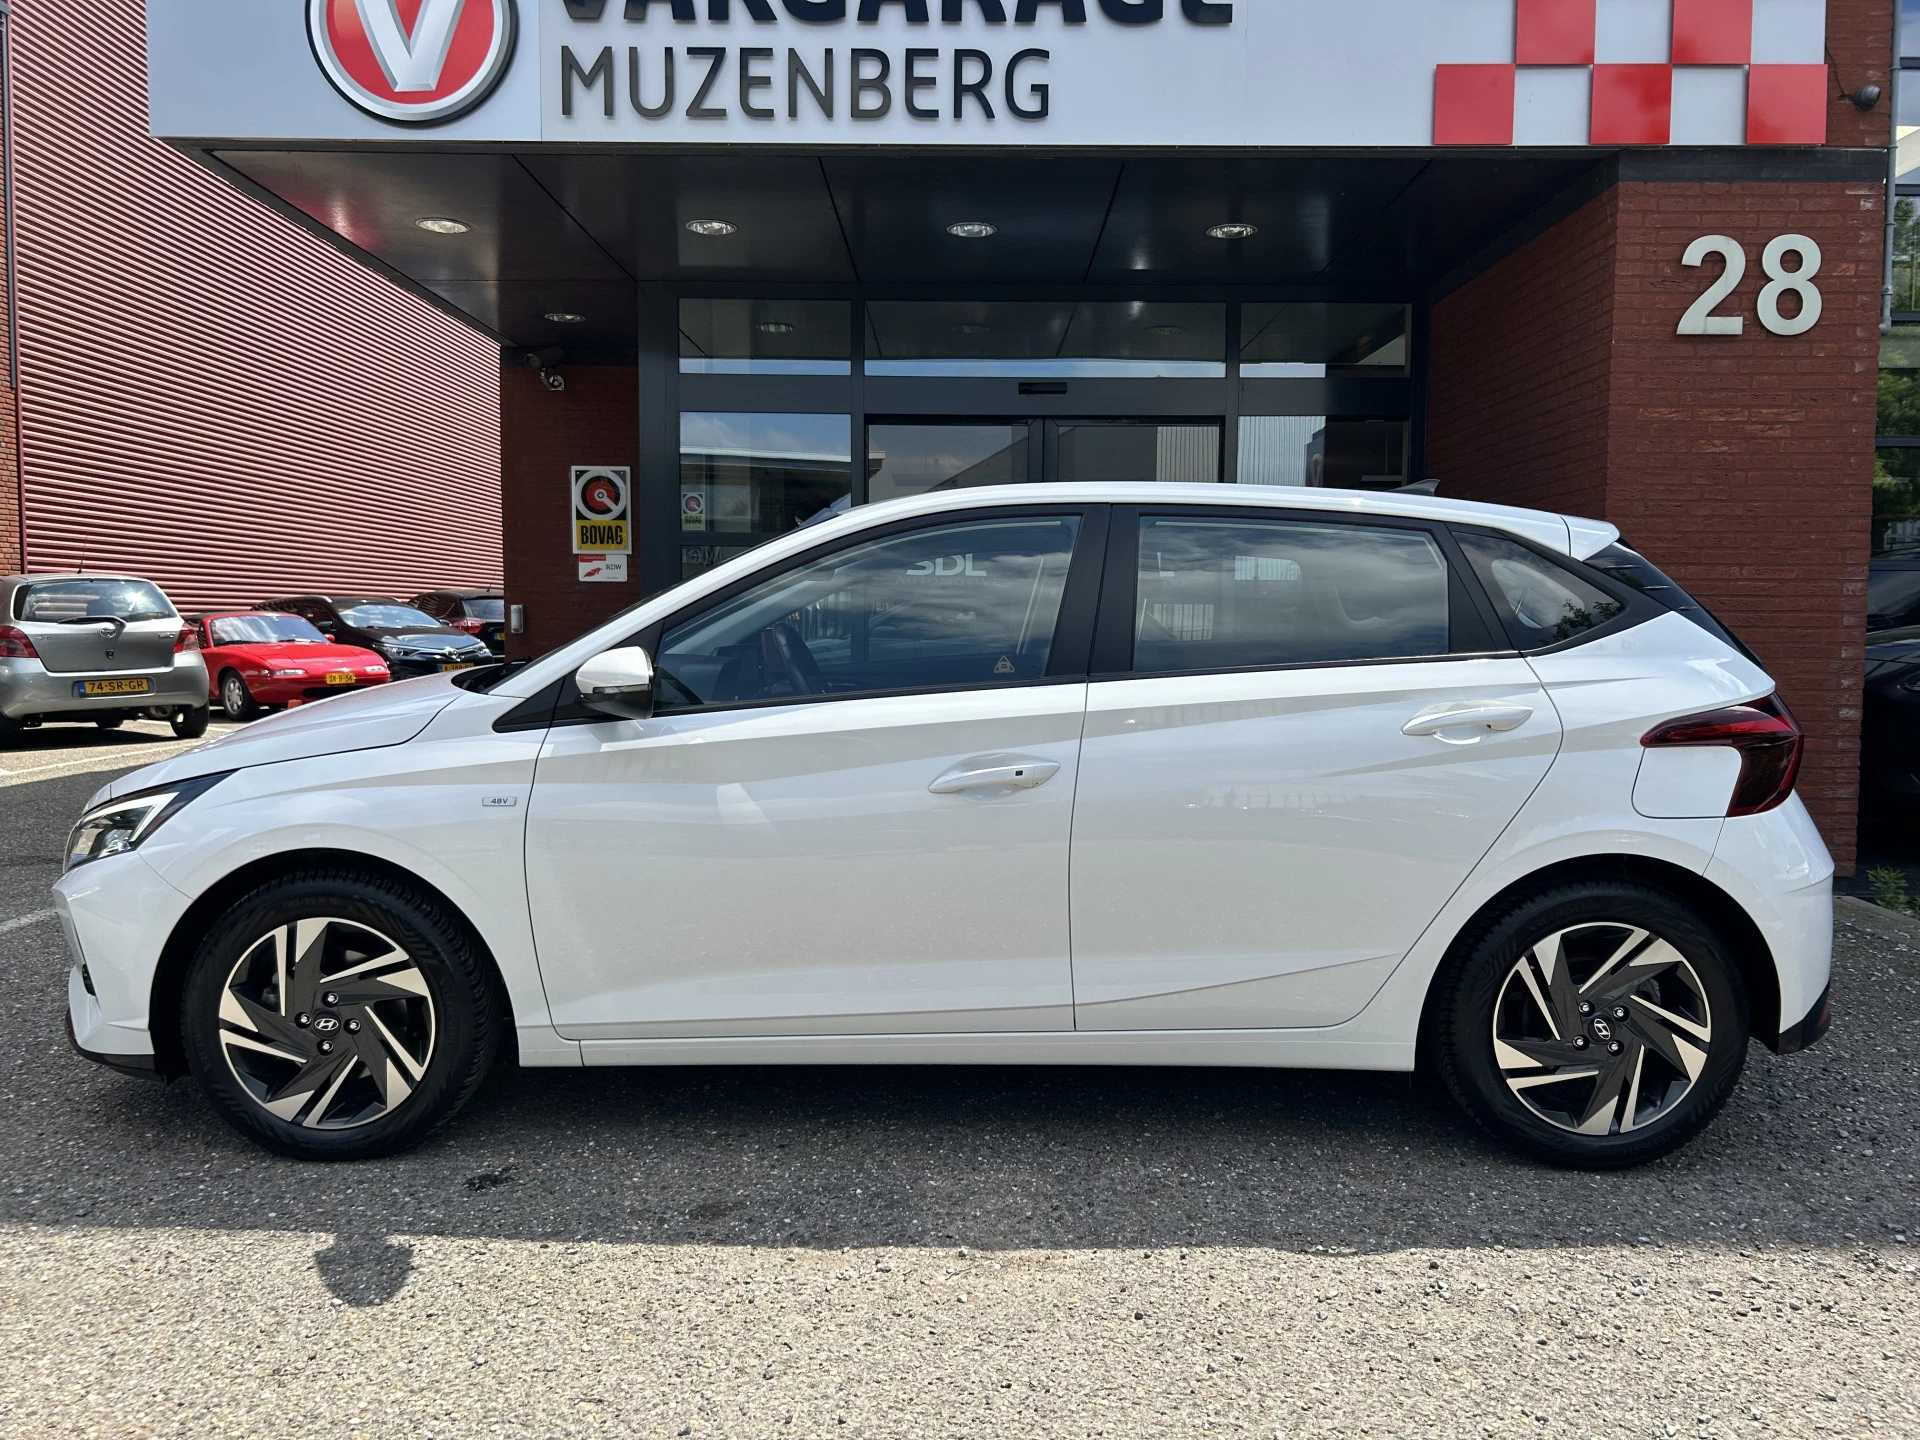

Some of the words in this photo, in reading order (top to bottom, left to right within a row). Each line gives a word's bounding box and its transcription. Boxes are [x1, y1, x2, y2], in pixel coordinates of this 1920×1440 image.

[560, 45, 1050, 120] MUZENBERG
[1676, 233, 1823, 336] 28
[580, 525, 623, 545] BOVAG
[905, 553, 988, 577] SDL
[90, 681, 145, 692] 74-SR-GR
